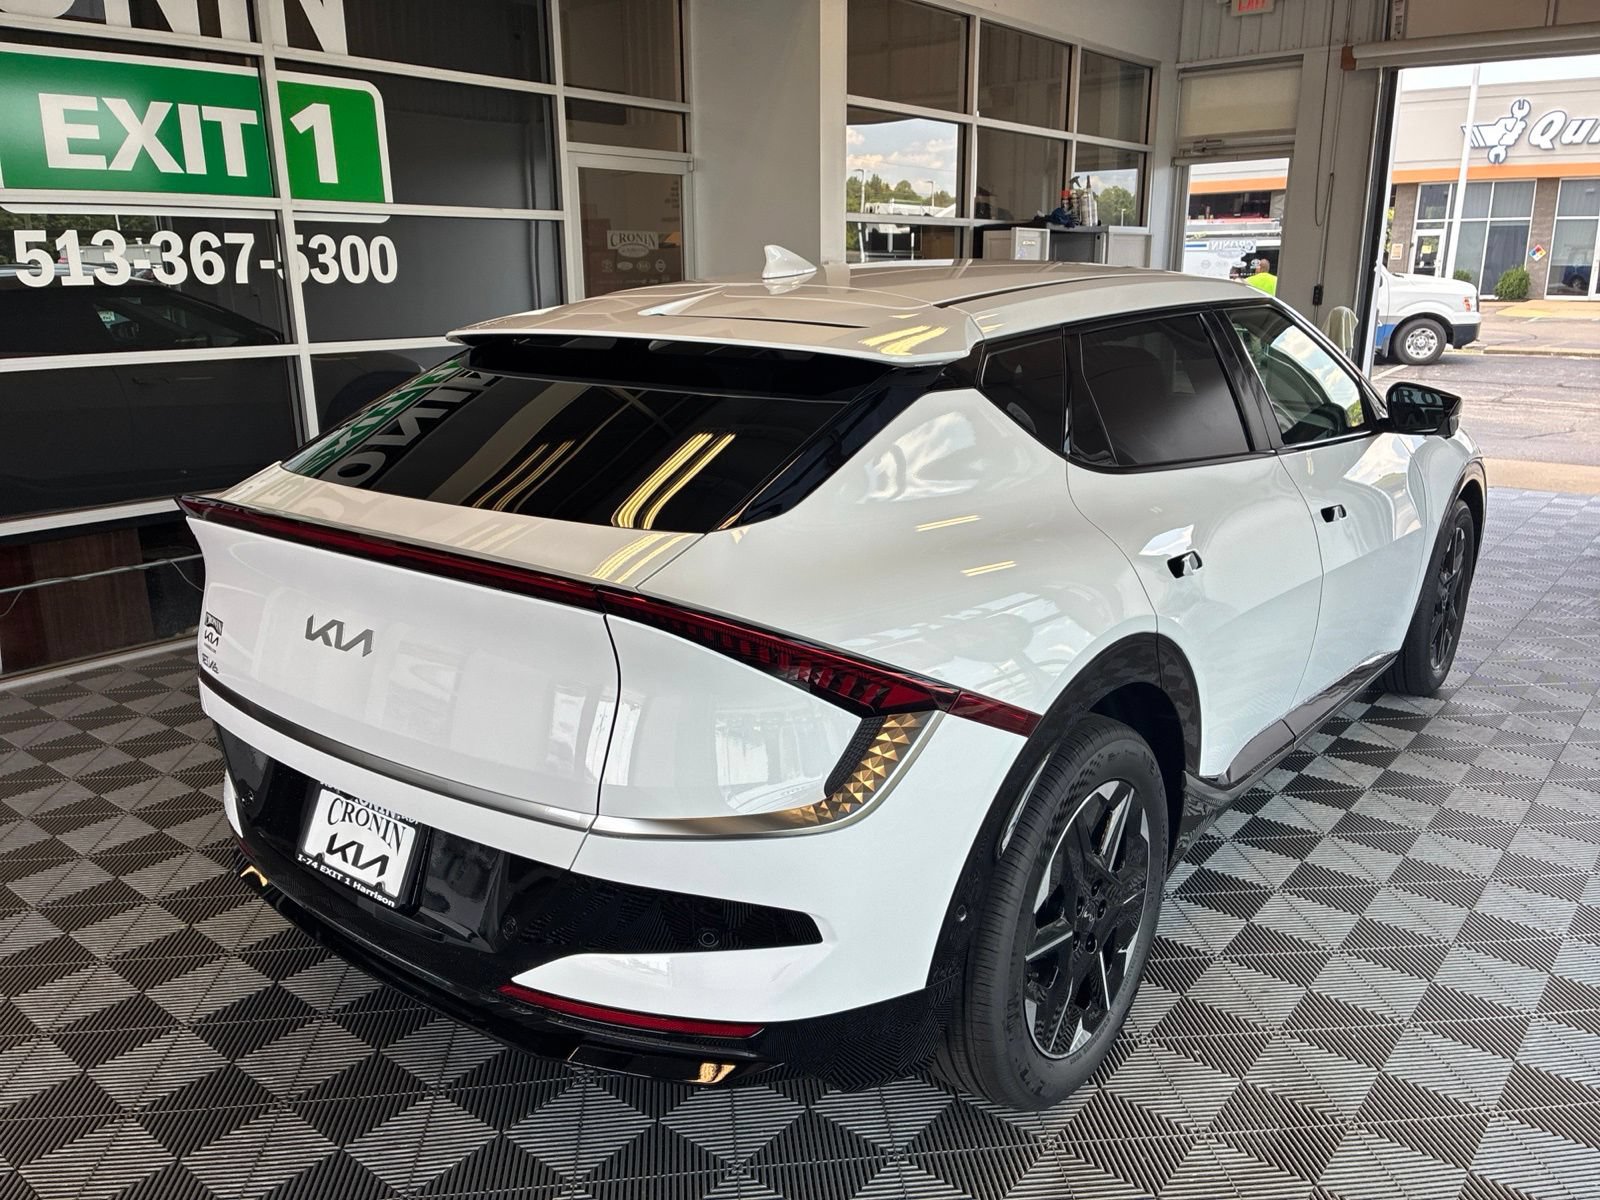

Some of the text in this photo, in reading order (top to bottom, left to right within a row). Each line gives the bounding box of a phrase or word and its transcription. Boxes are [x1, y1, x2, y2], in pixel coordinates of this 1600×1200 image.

[38, 93, 339, 184] EXIT 1
[14, 229, 398, 287] 513-367-5300
[610, 232, 656, 248] CRONIN
[305, 614, 374, 657] KIA
[327, 797, 406, 857] CRONIN
[297, 853, 396, 908] I-74 EXIT 1 Harrison
[325, 832, 390, 878] KIA
